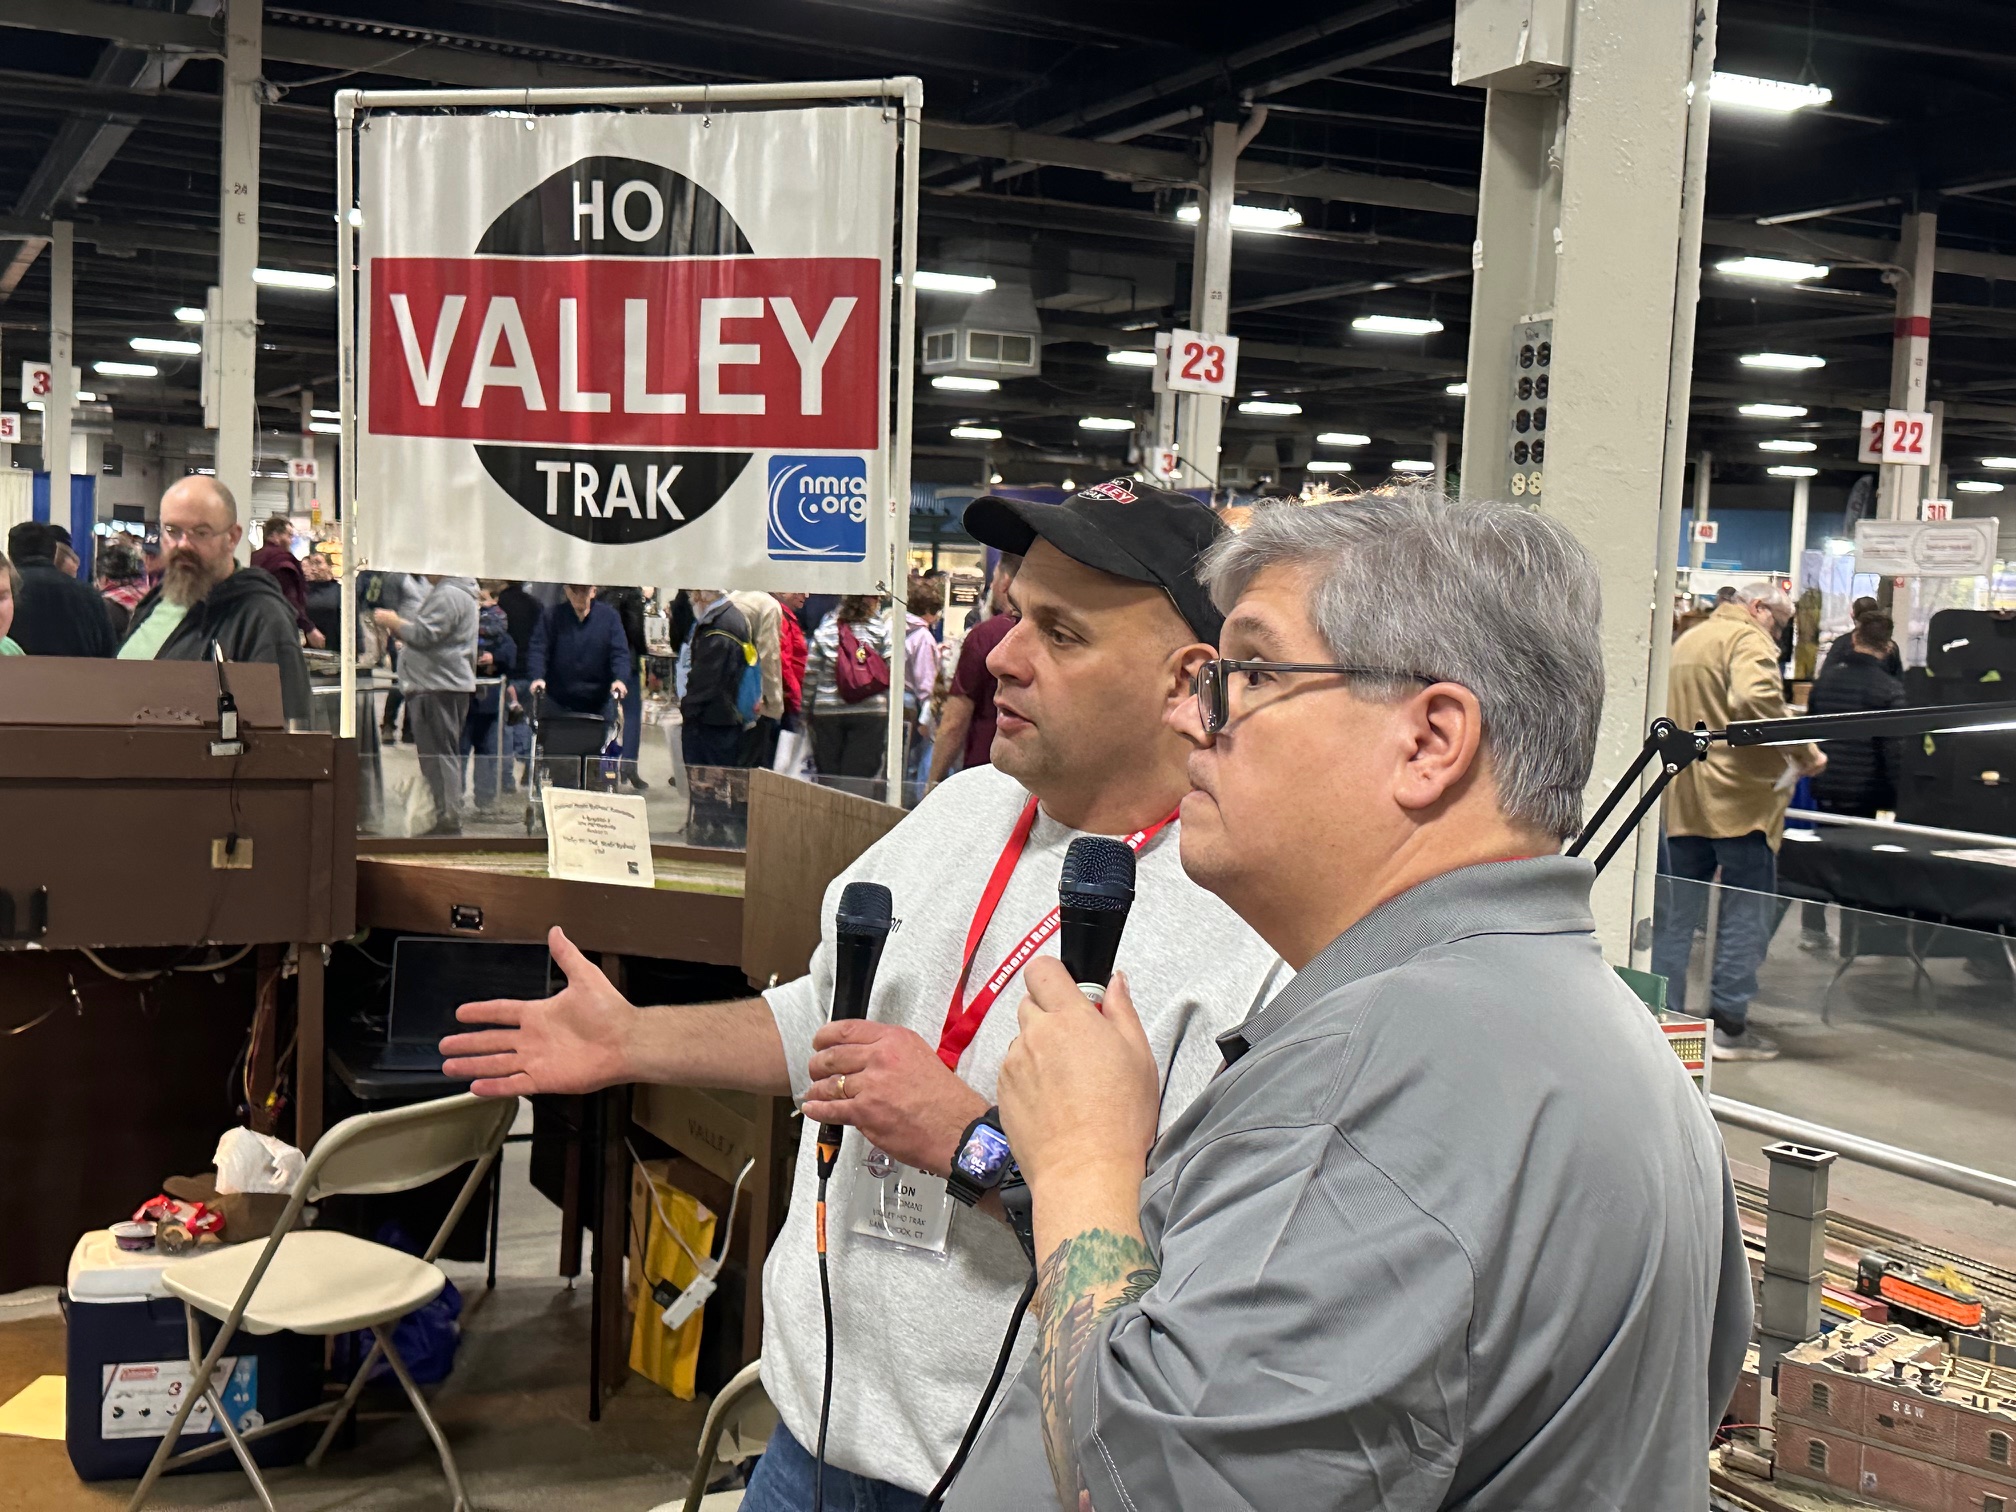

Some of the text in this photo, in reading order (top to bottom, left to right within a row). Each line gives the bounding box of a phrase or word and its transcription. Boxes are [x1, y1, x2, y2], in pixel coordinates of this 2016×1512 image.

[572, 179, 664, 242] HO
[388, 293, 859, 416] VALLEY
[1180, 341, 1226, 384] 23
[32, 369, 51, 397] 3
[0, 416, 14, 437] 5
[1869, 421, 1884, 454] 2
[1892, 420, 1924, 454] 22
[1162, 453, 1176, 473] 3
[535, 460, 686, 521] TRAK
[799, 475, 867, 495] nmra
[809, 495, 867, 523] .org
[1126, 830, 1146, 850] ow
[688, 1117, 735, 1157] VALLEY
